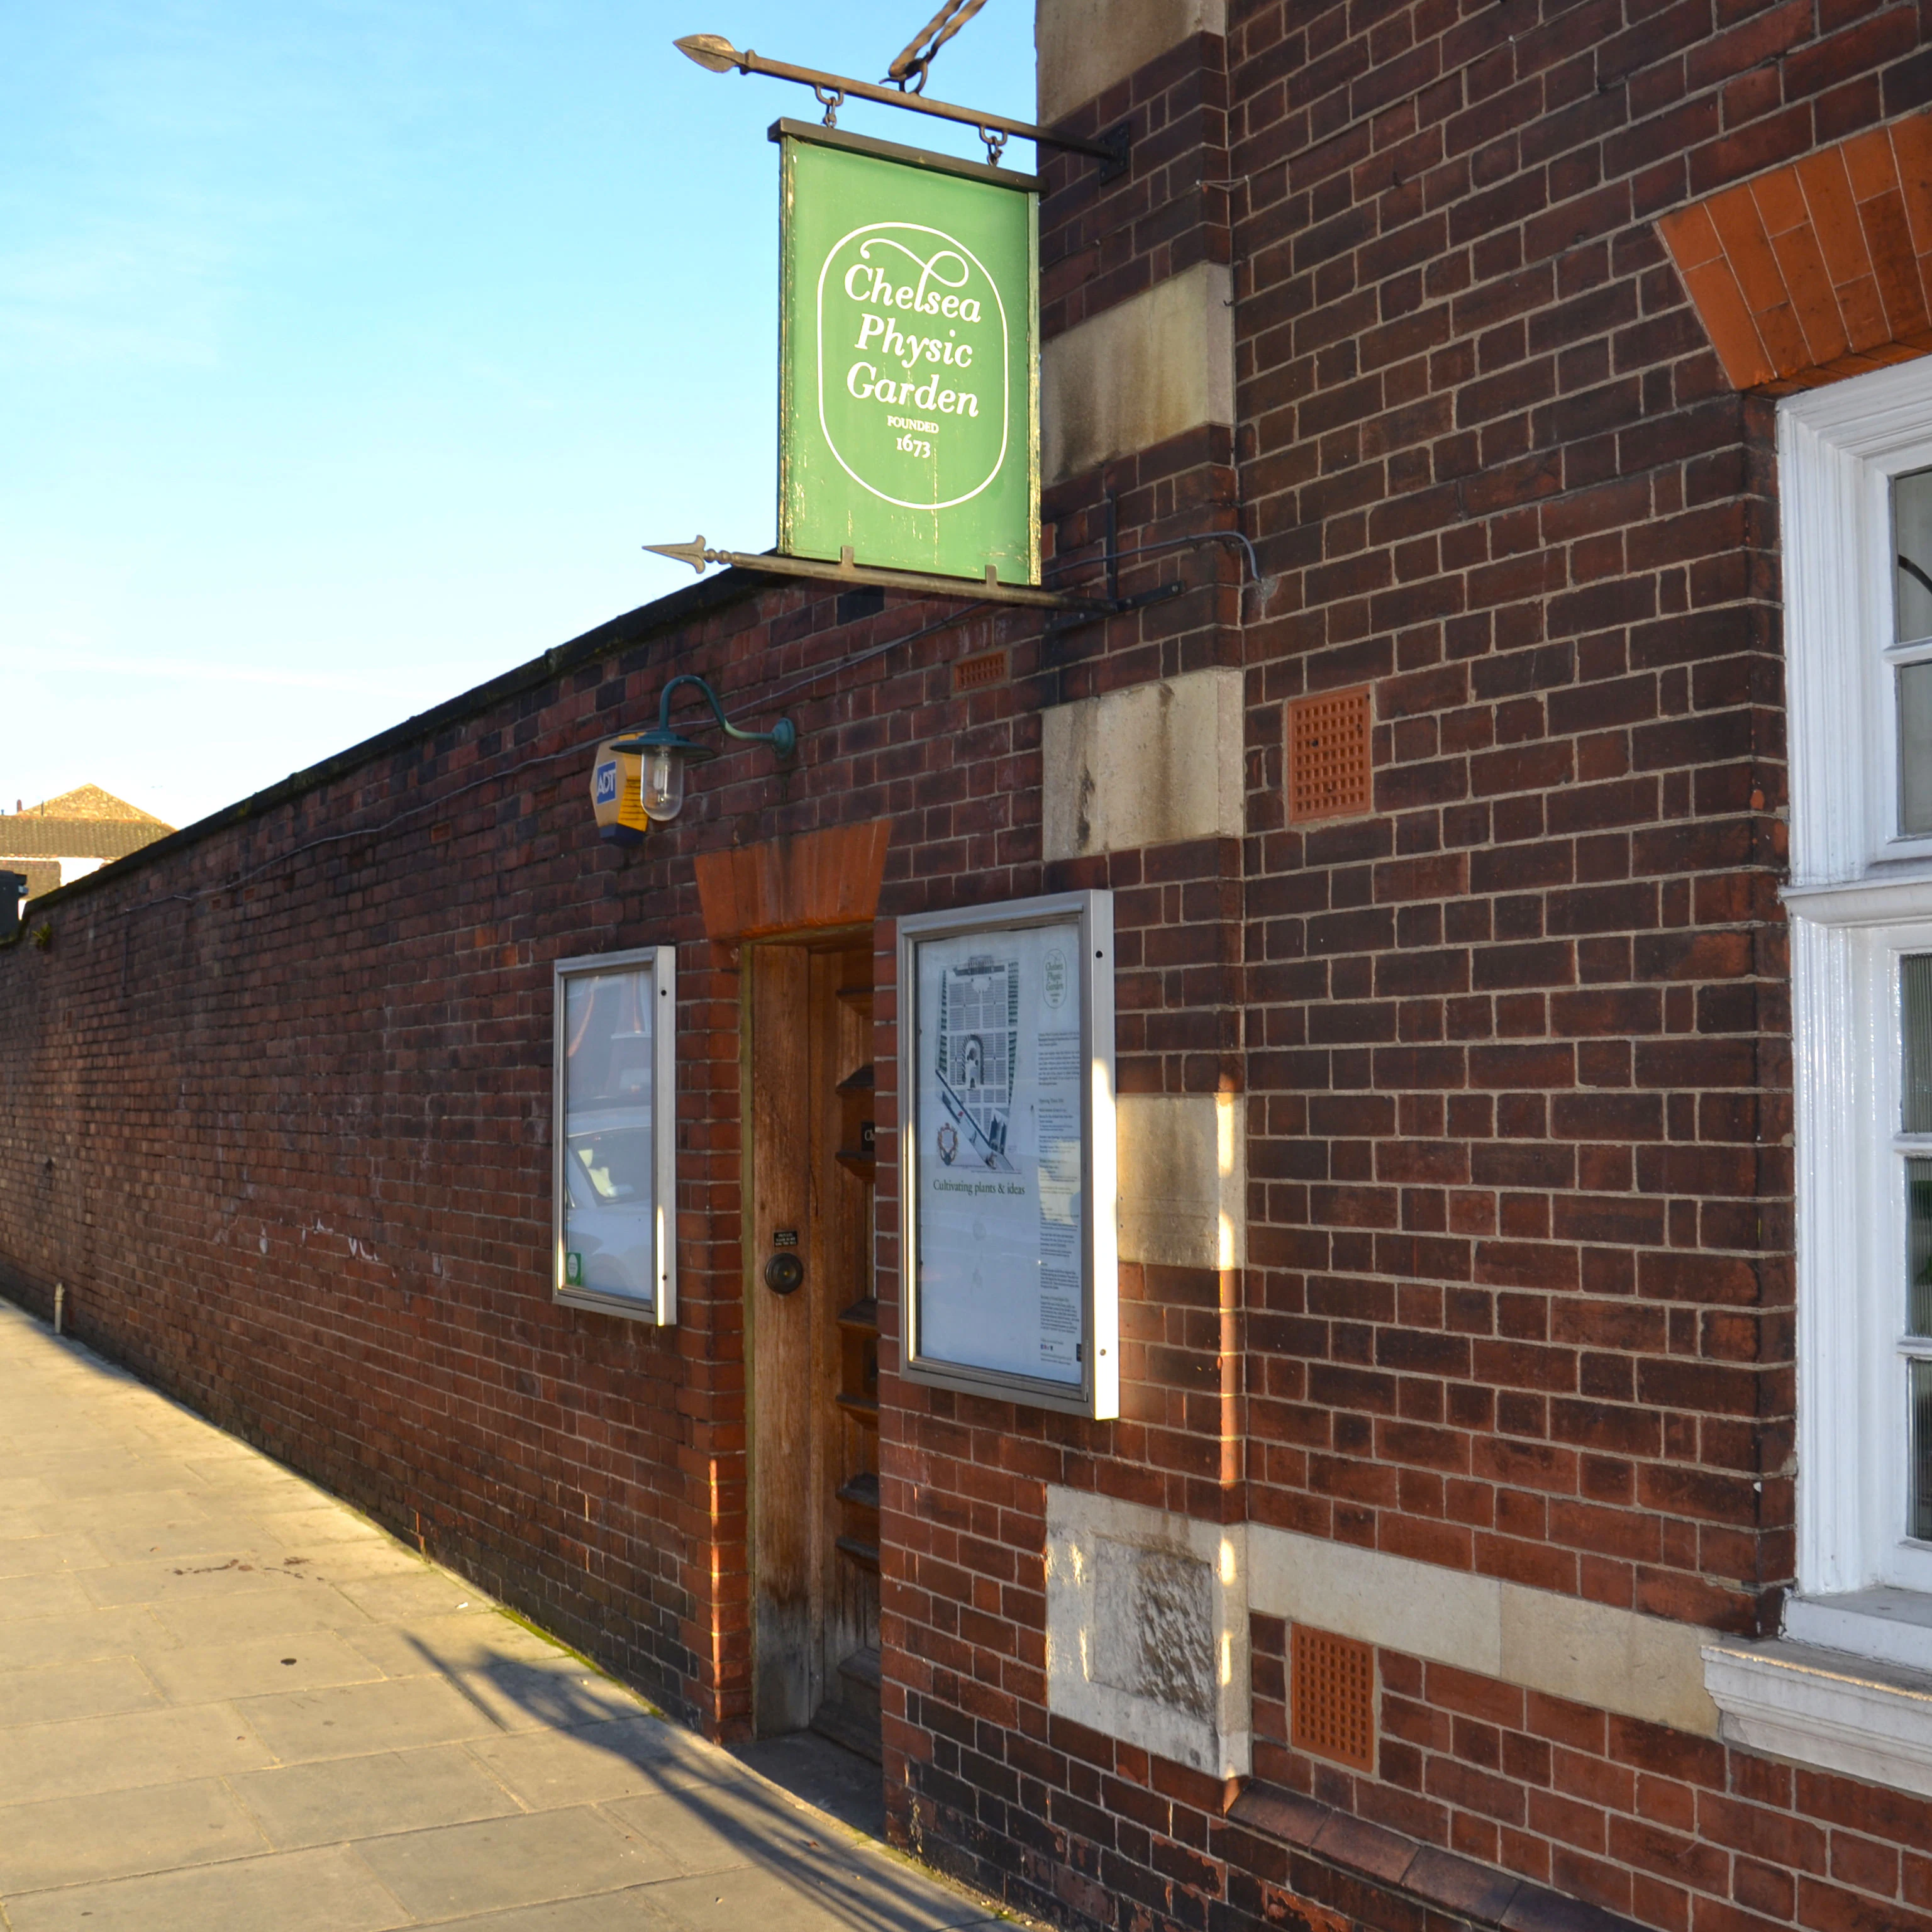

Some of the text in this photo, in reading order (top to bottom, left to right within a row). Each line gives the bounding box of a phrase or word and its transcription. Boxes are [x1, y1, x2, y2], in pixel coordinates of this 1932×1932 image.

[845, 240, 981, 323] Chelsea
[855, 313, 973, 369] Physic
[847, 362, 979, 417] Garden
[887, 415, 940, 434] FOUNDED
[896, 433, 931, 458] 1673
[597, 769, 616, 796] ADT
[933, 1179, 973, 1196] Cultivating
[975, 1181, 996, 1196] plants
[998, 1183, 1005, 1194] &
[1007, 1182, 1025, 1195] ideas
